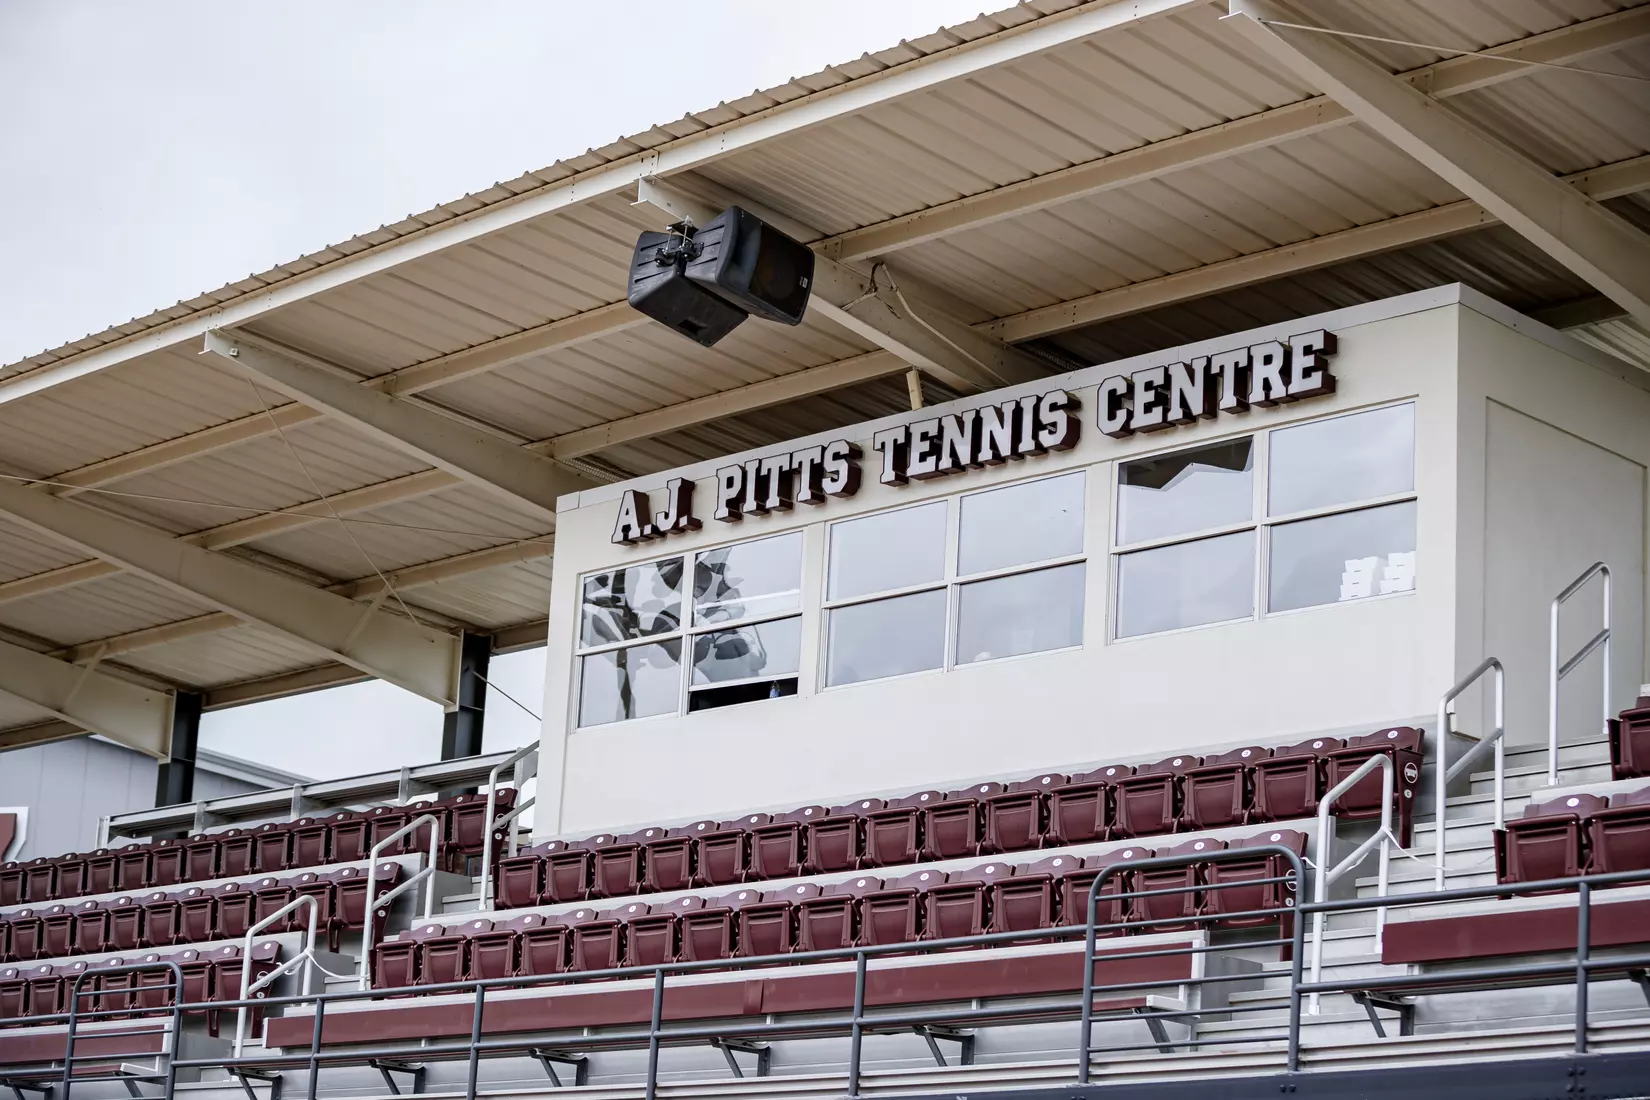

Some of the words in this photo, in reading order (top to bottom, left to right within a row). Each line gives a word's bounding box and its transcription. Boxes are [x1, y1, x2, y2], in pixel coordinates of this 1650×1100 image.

[611, 477, 701, 545] A.J.
[714, 439, 862, 523] PITTS
[873, 389, 1081, 487] TENNIS
[1097, 328, 1337, 439] CENTRE
